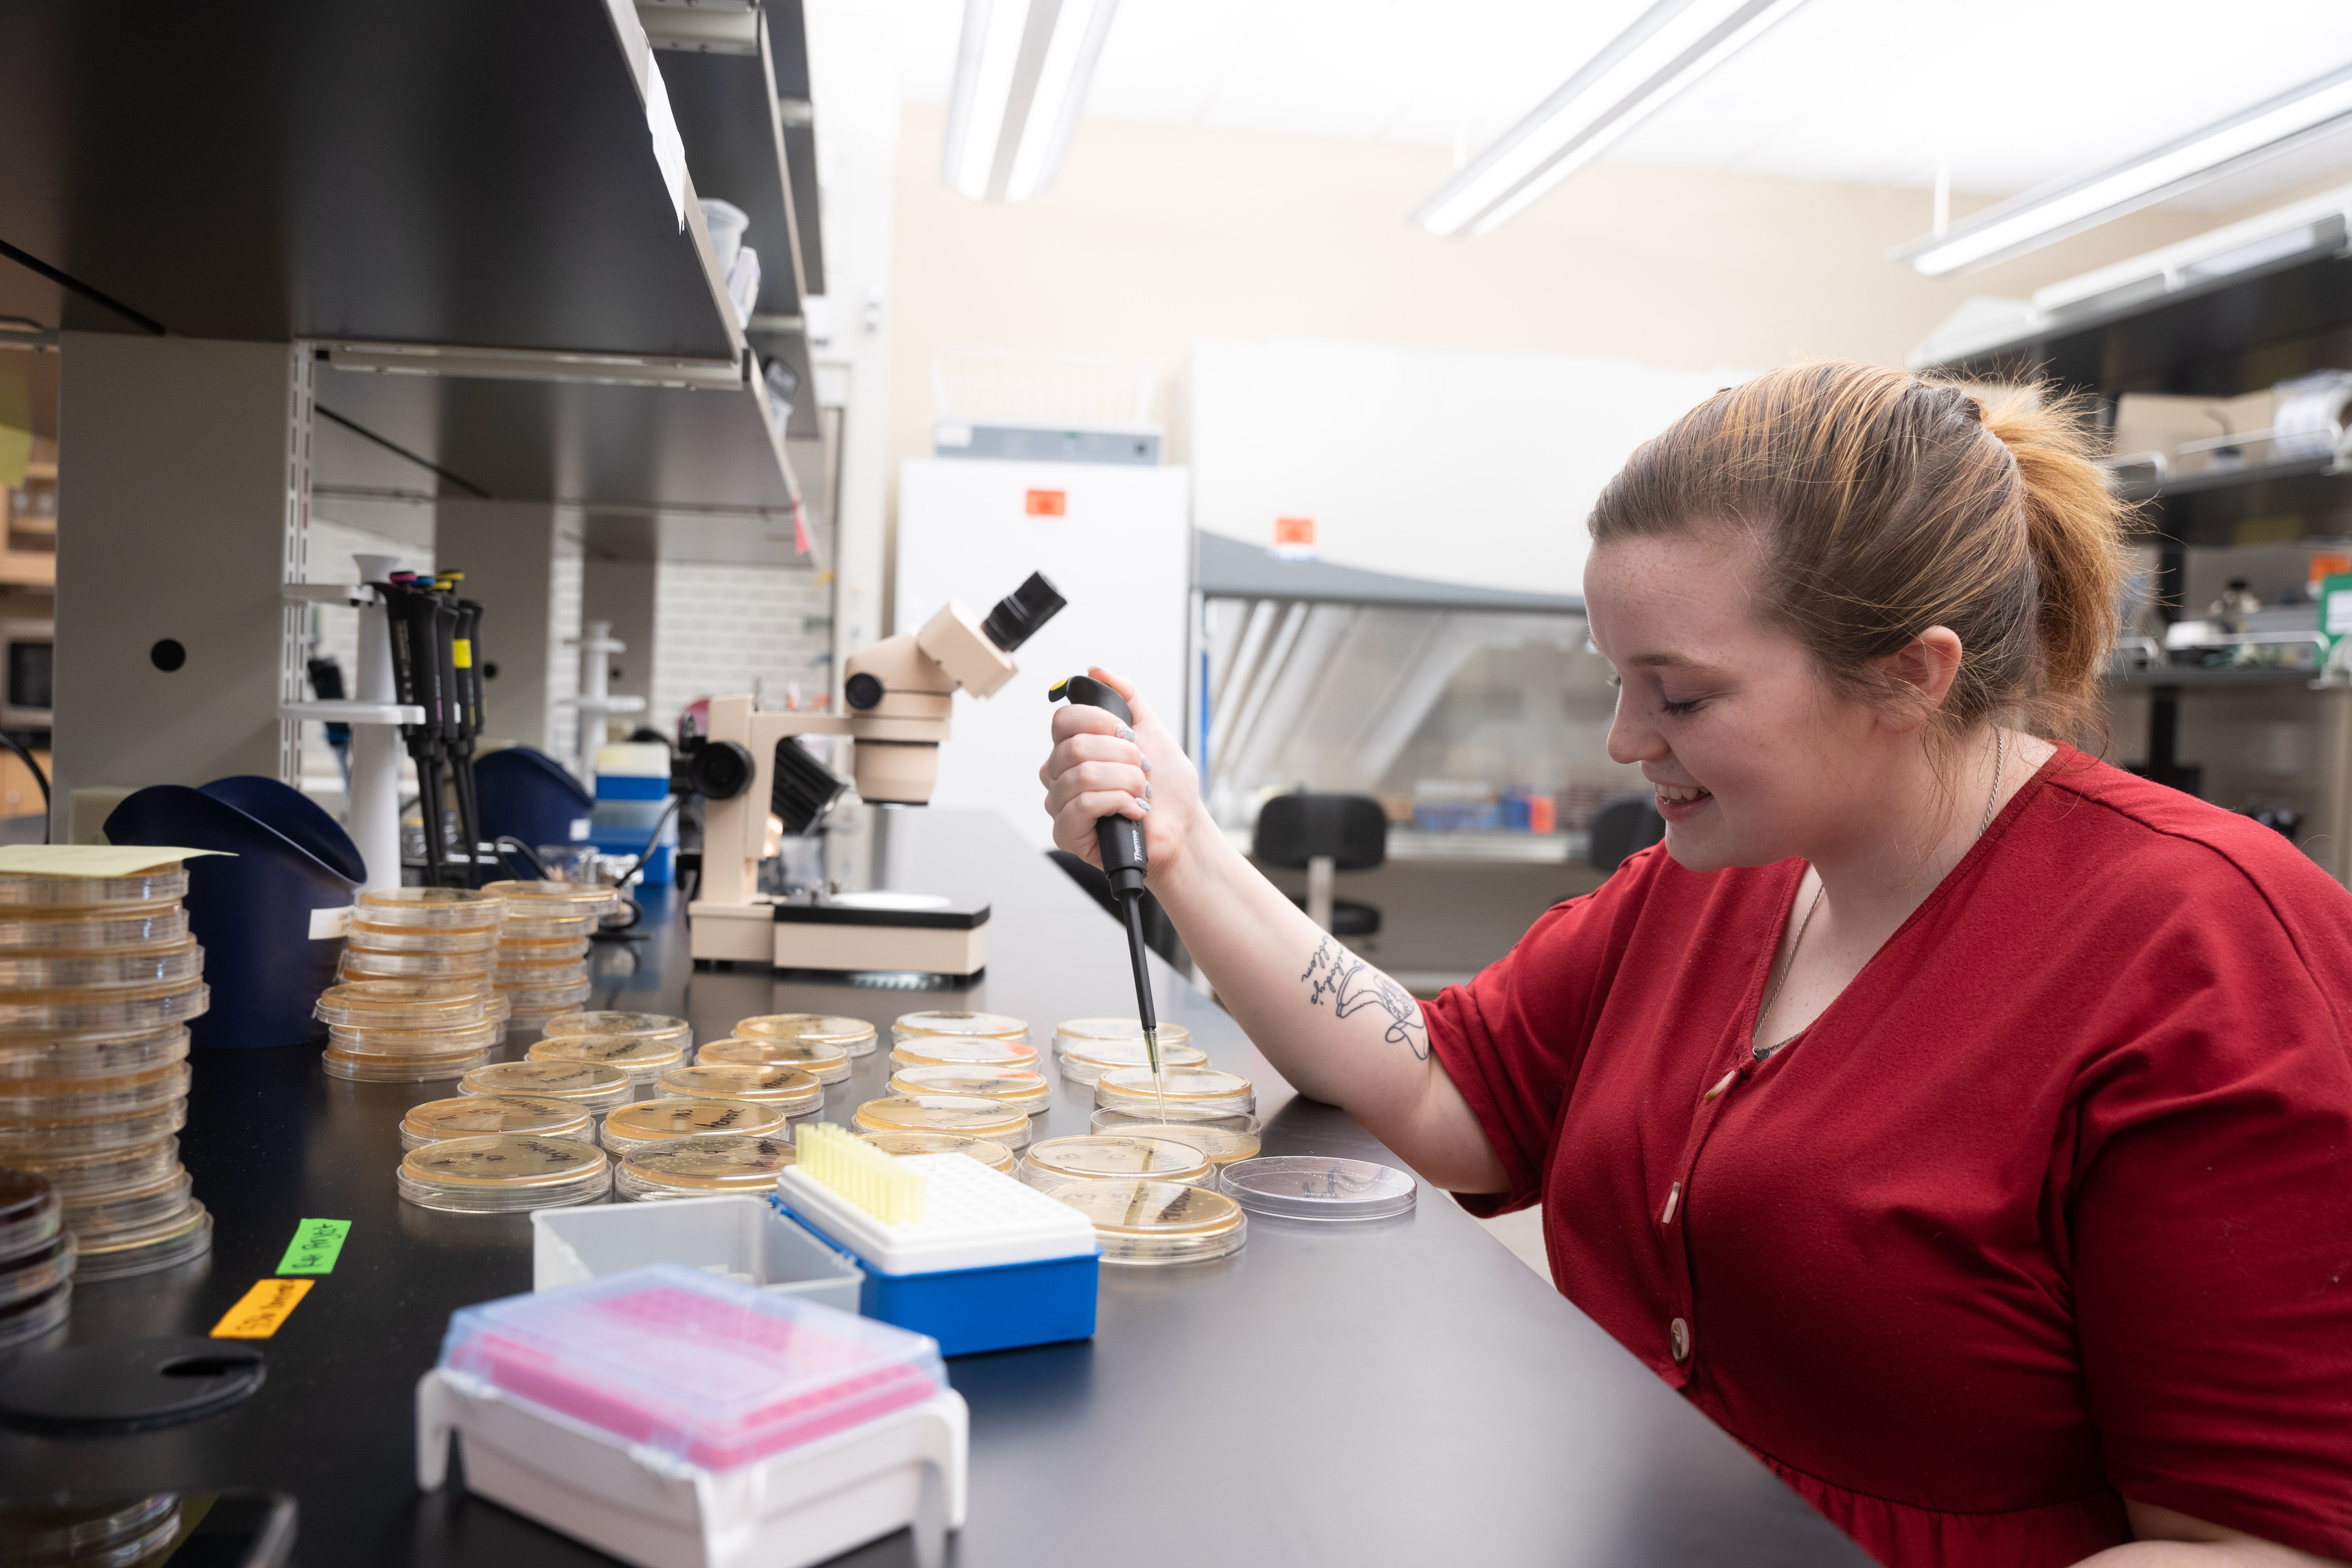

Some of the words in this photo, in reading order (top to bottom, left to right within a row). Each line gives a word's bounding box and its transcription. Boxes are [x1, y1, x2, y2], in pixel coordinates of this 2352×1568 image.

[488, 1096, 565, 1116] Anaerobic
[926, 1106, 1014, 1124] Anaerobic
[693, 1108, 746, 1129] Aerobic
[517, 1141, 579, 1162] Aerobic
[1118, 1139, 1190, 1167] Anaerobic
